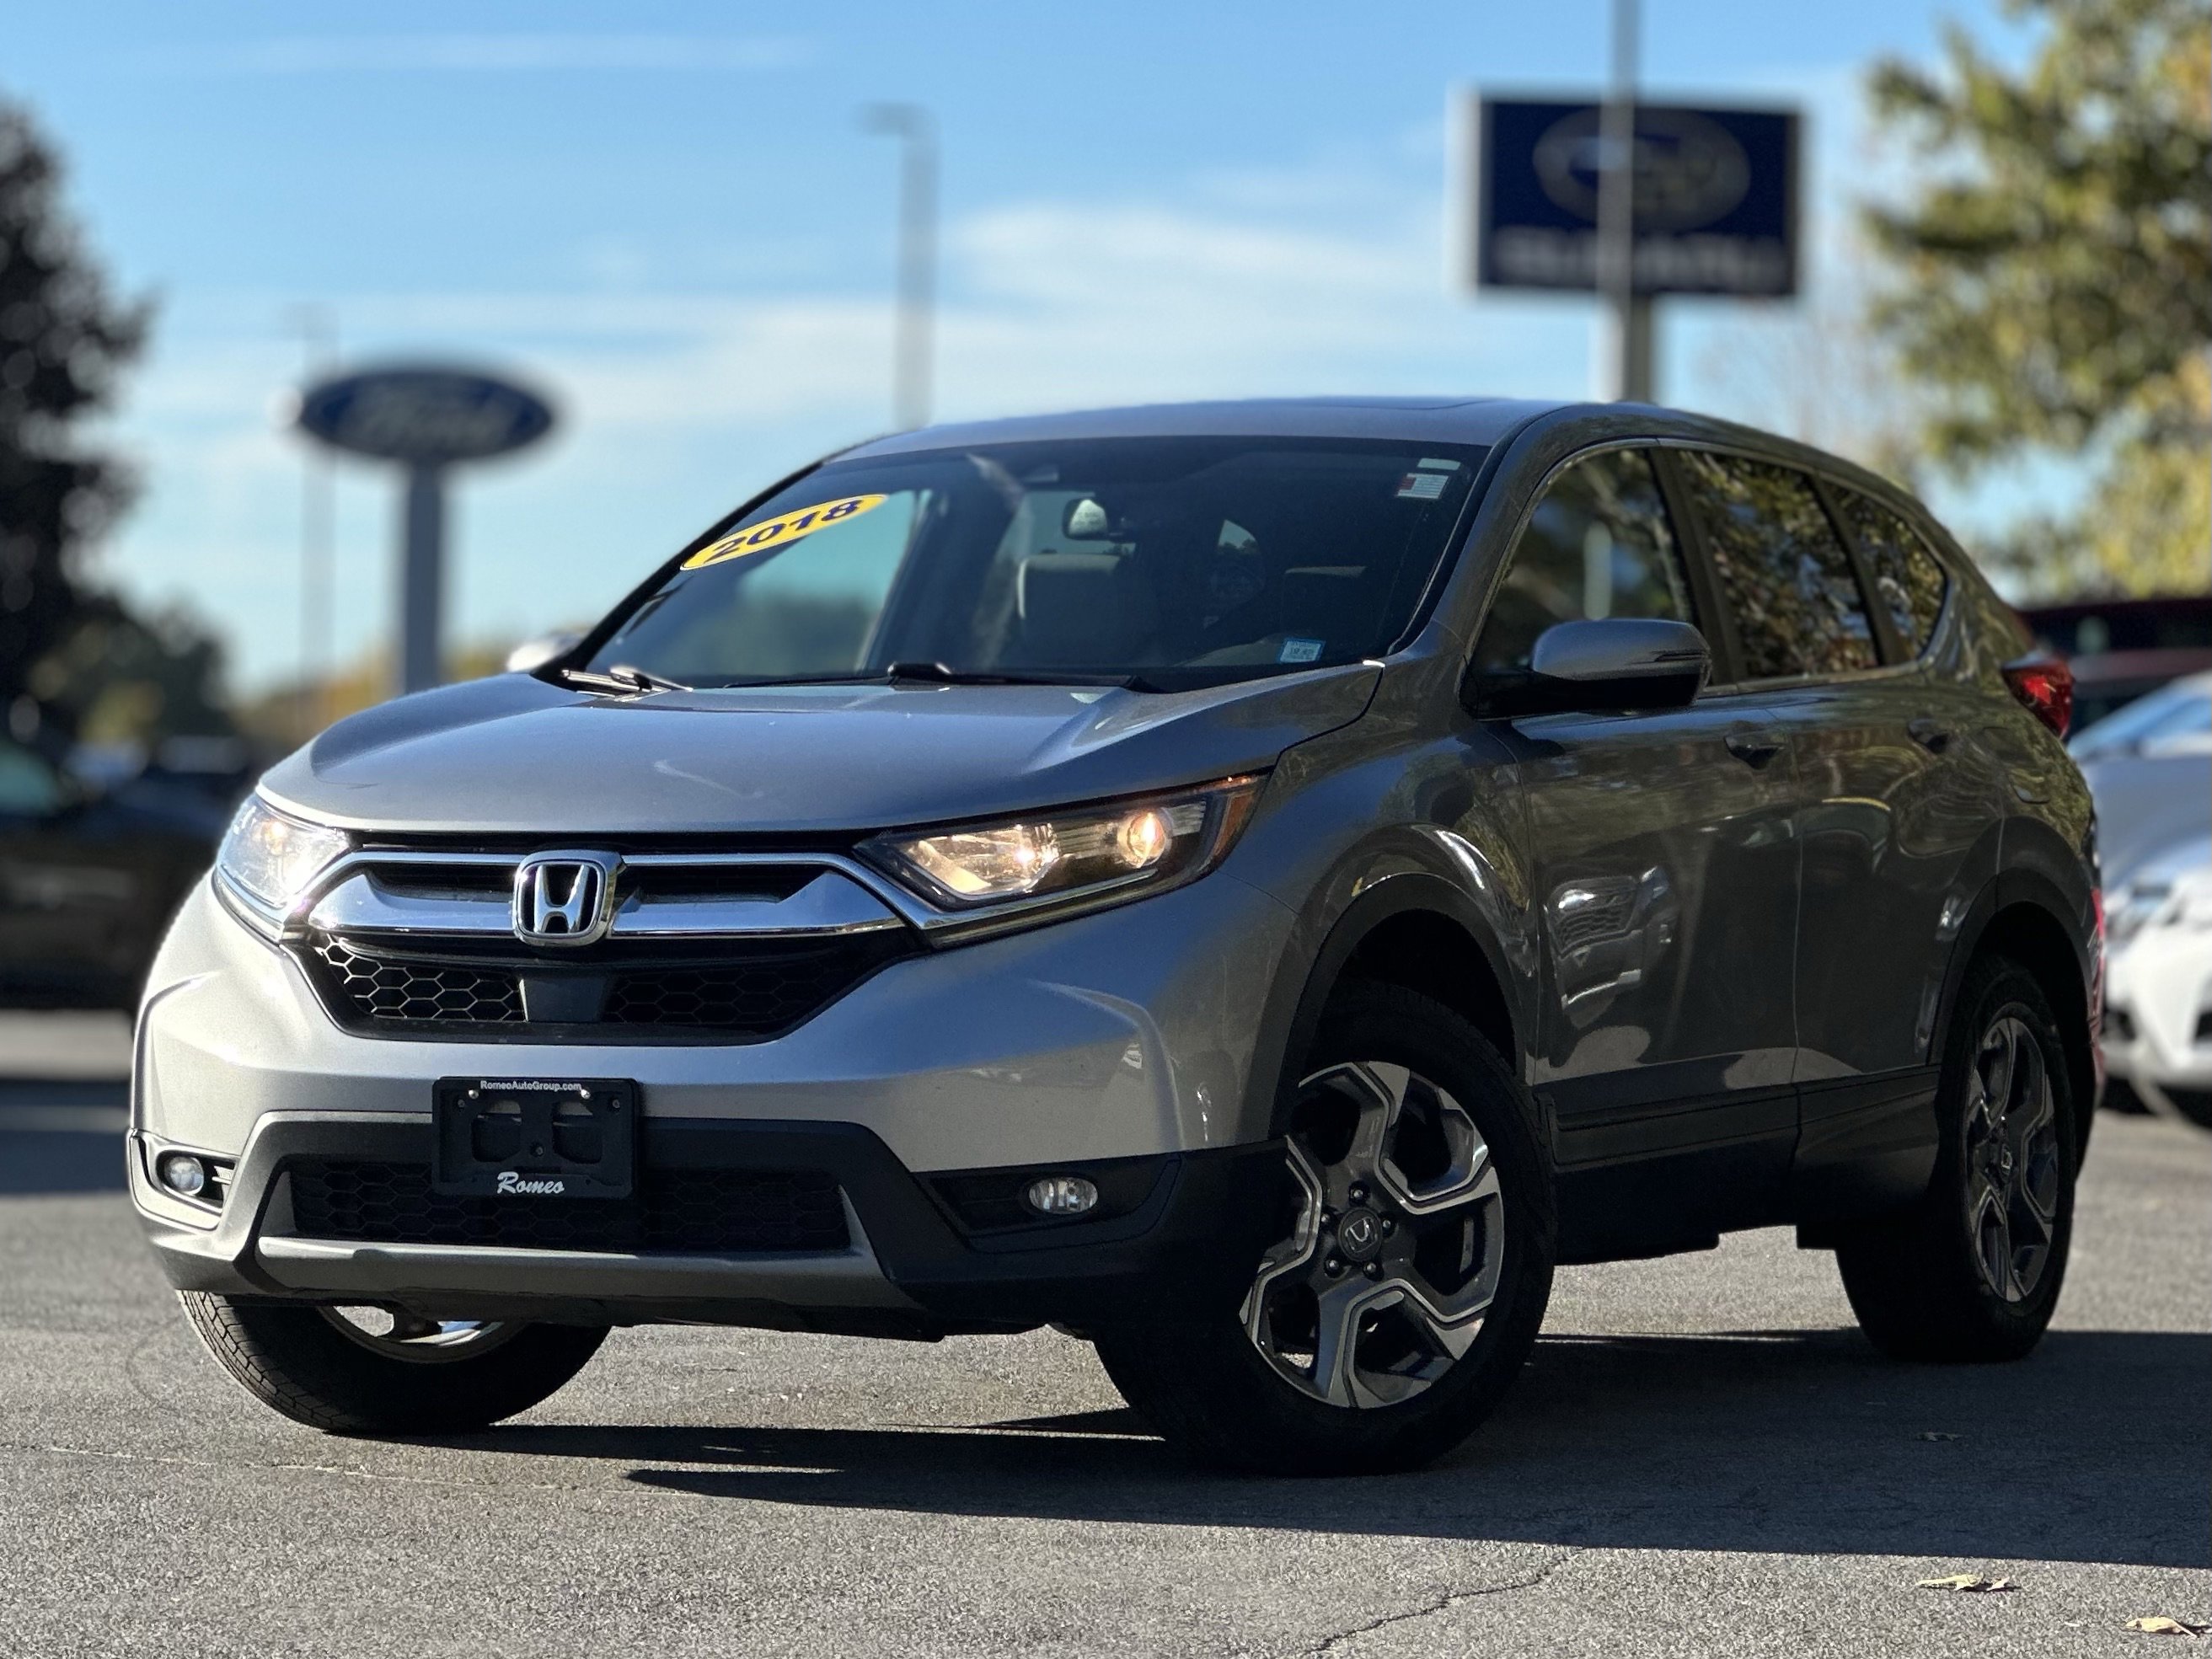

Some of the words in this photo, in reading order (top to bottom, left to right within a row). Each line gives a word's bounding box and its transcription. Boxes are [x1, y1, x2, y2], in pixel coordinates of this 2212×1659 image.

[703, 500, 865, 565] 2018
[479, 1079, 582, 1093] RomeoAutoGroup.com
[496, 1171, 565, 1194] Romeo
